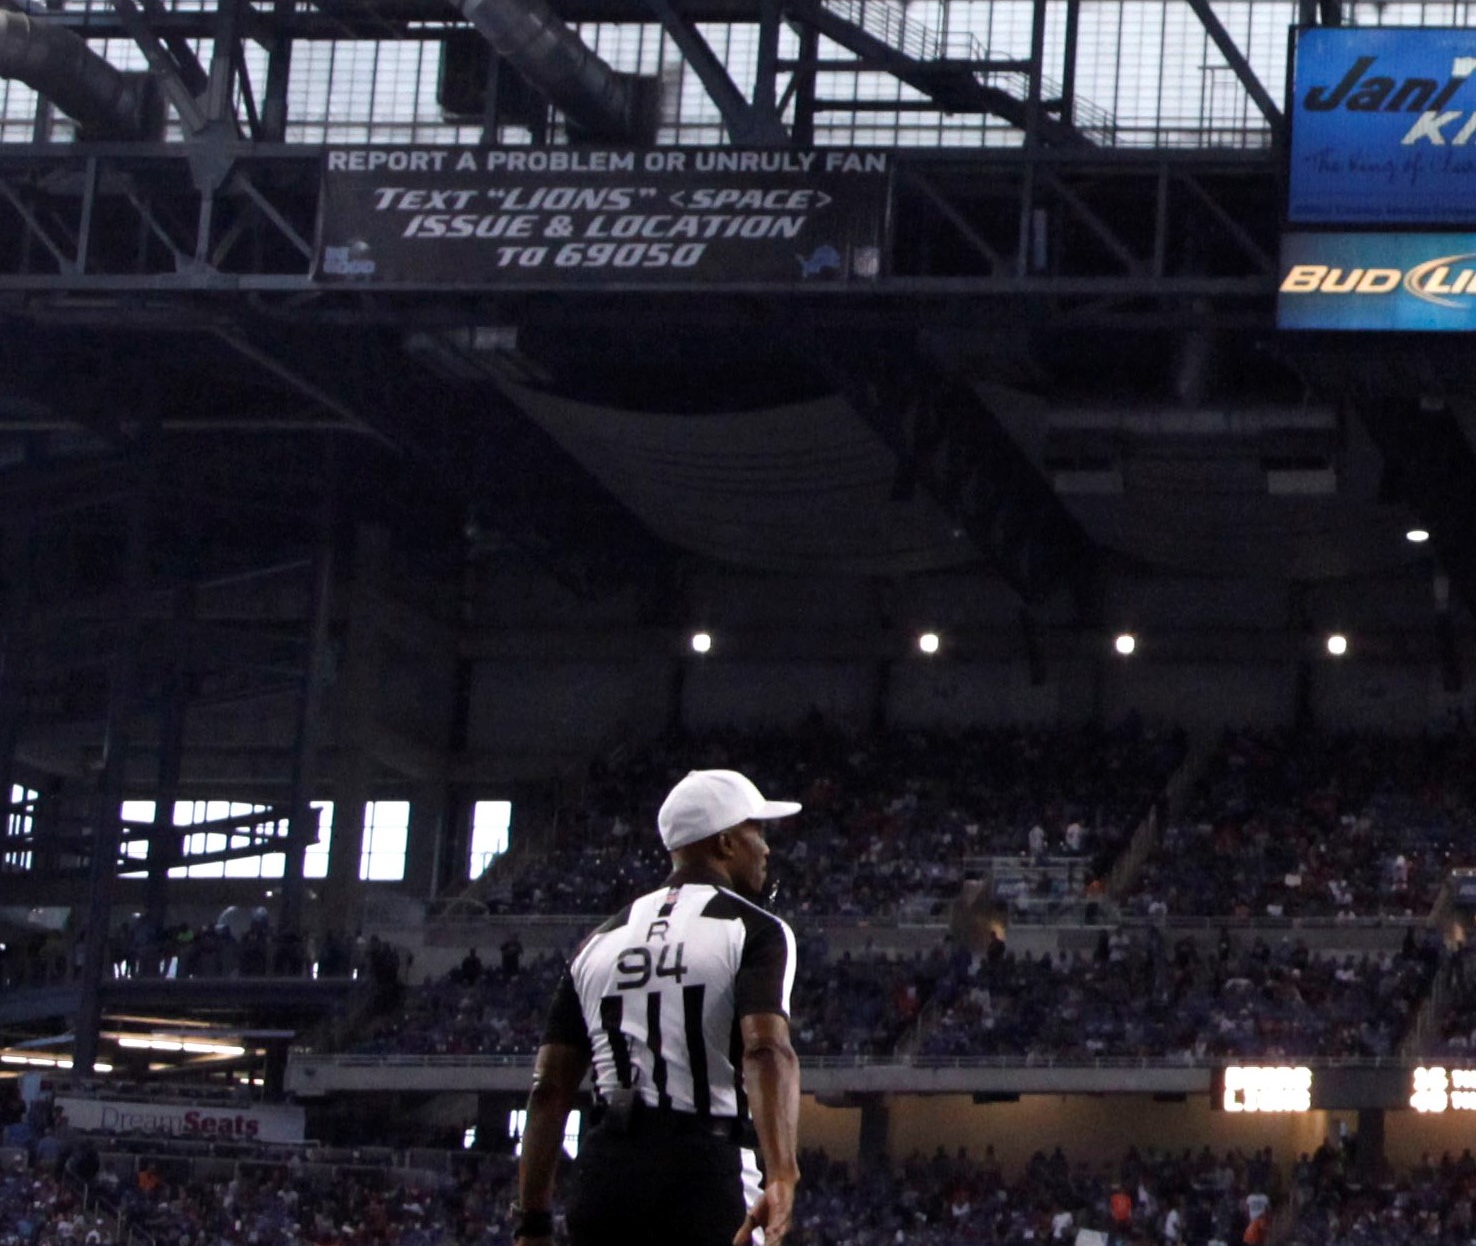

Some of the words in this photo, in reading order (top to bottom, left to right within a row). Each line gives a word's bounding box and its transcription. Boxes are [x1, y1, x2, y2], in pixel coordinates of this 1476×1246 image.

[328, 151, 446, 172] REPORT
[456, 151, 477, 172] A
[487, 151, 634, 172] PROBLEM
[646, 151, 685, 172] OR
[696, 151, 814, 172] UNRULY
[826, 151, 887, 172] FAN
[403, 215, 533, 237] ISSUE
[542, 215, 573, 237] &
[584, 215, 806, 237] LOCATION
[554, 243, 706, 267] 69050
[1279, 265, 1402, 294] BUD
[647, 920, 670, 942] R
[616, 941, 688, 990] 94
